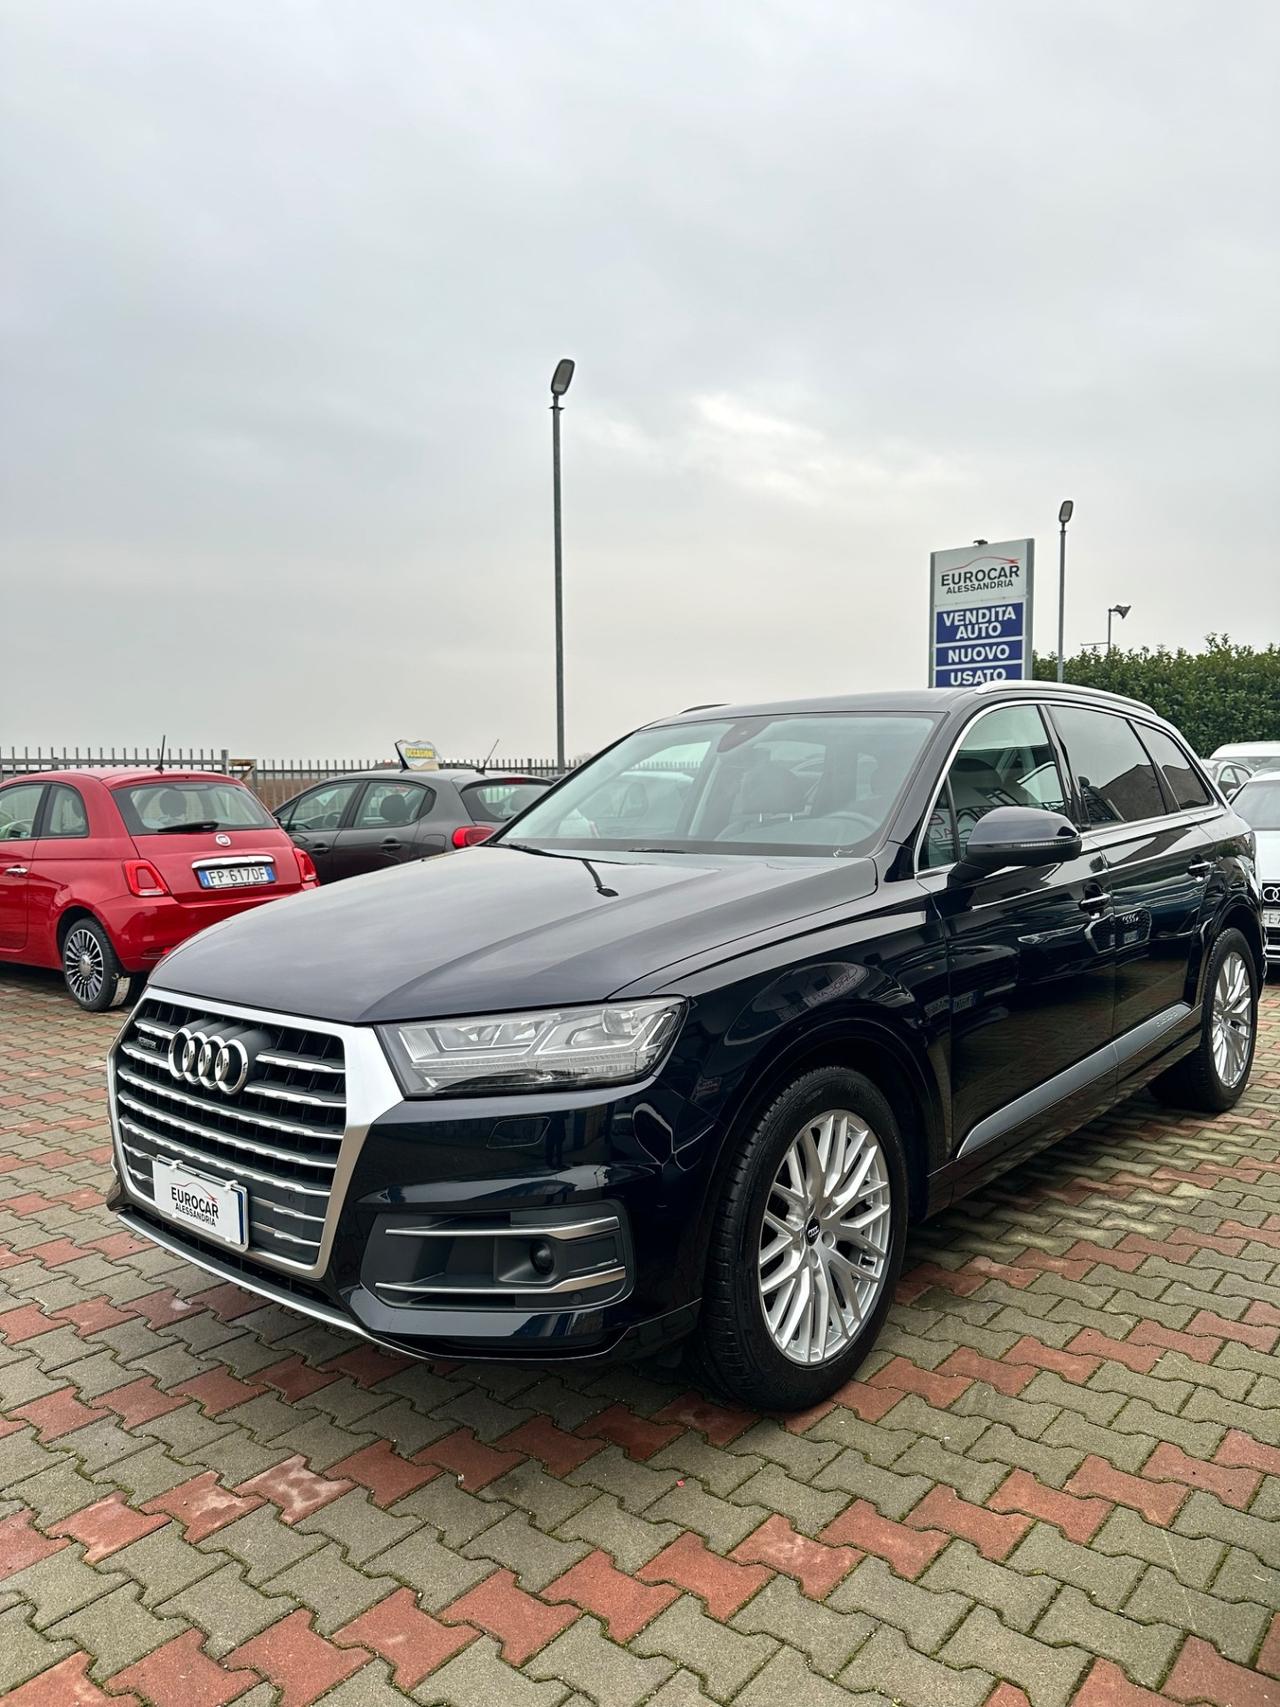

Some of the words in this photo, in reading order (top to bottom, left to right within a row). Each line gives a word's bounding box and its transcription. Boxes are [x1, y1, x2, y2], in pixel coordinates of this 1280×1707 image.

[941, 565, 1020, 586] EUROCAR
[946, 579, 1014, 595] ALESSANDRIA
[943, 606, 1016, 627] VENDITA
[956, 622, 1001, 640] AUTO
[948, 645, 1010, 663] NUOVO
[950, 668, 1006, 686] USATO
[171, 1186, 219, 1219] EUROCAR
[175, 1202, 216, 1227] ALESSANDRIA
